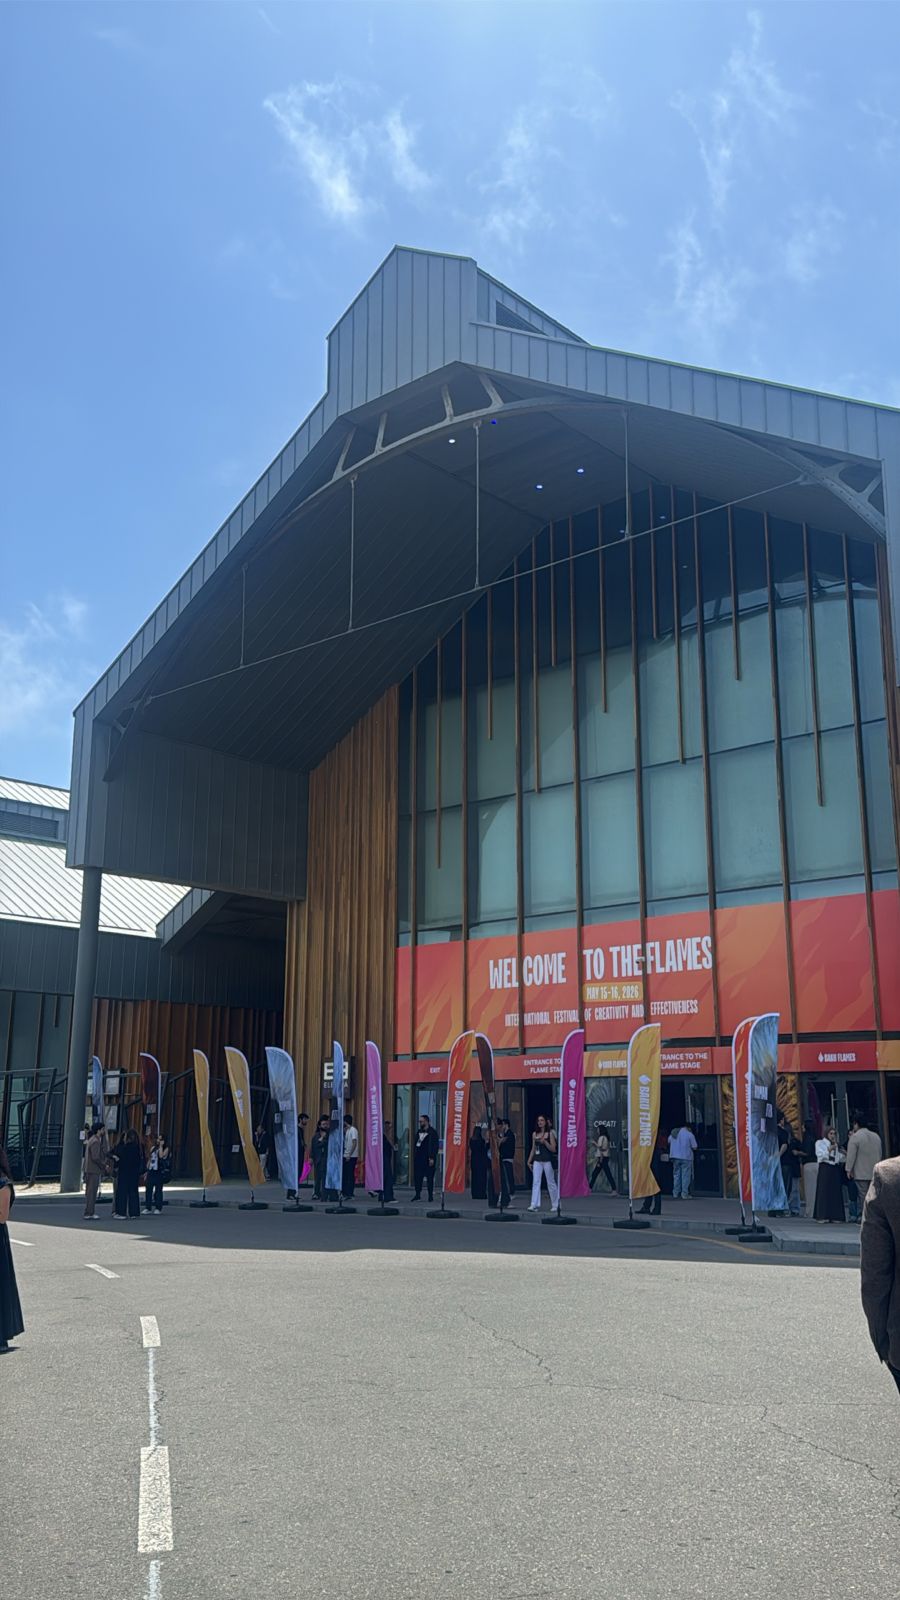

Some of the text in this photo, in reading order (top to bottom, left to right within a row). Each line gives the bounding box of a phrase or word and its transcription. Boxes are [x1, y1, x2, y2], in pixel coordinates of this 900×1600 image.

[489, 936, 712, 990] WELCOME TO THE FLAMES
[586, 985, 639, 1000] MAY 15-16, 2026
[554, 1009, 580, 1025] FESTIVAL
[584, 1008, 592, 1021] OF
[595, 1005, 629, 1020] CREATIVITY
[632, 1004, 645, 1018] AND
[650, 1000, 698, 1016] EFFECTIVENESS
[523, 1058, 553, 1067] ENTRANCE
[661, 1061, 701, 1070] LAME STAGE
[695, 1052, 708, 1060] THE
[530, 1066, 549, 1074] FLAME
[453, 1090, 465, 1146] BAKU FLAMES
[640, 1086, 652, 1147] BAKU FLAMES
[566, 1114, 577, 1148] FLAMES
